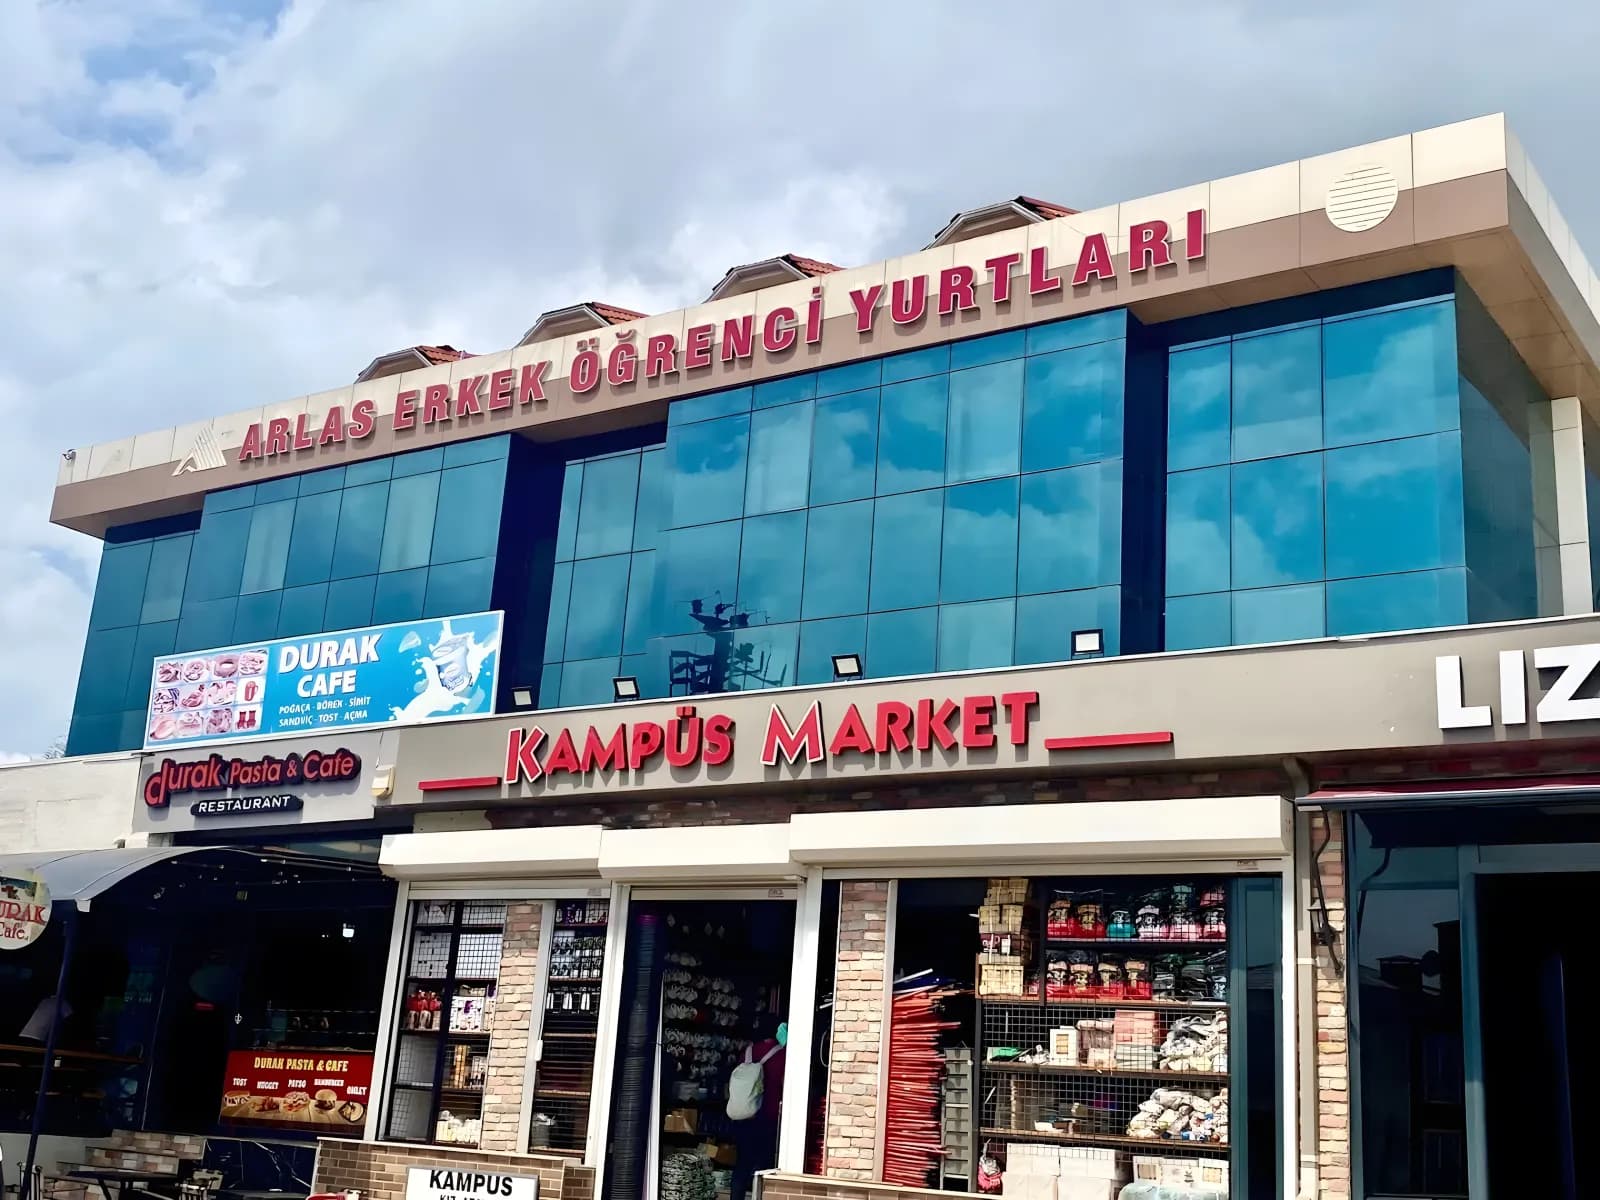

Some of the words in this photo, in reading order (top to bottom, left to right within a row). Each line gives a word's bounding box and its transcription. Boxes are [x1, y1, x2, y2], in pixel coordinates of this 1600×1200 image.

[238, 399, 376, 461] ARLAS
[392, 360, 551, 432] ERKEK
[569, 286, 822, 394] ÖĞRENCİ
[849, 208, 1206, 333] YURTLARI
[278, 633, 383, 674] DURAK
[297, 669, 357, 699] CAFE
[278, 703, 311, 715] POĞAÇA
[318, 712, 339, 723] TOST
[343, 709, 368, 722] AÇMA
[503, 705, 734, 785] KAMPÜS
[760, 691, 1039, 766] MARKET
[229, 759, 281, 786] Pasta
[286, 757, 298, 777] &
[303, 750, 355, 780] Cafe
[198, 795, 291, 813] RESTAURANT
[254, 1056, 285, 1070] DURAK
[286, 1058, 314, 1071] PASTA
[325, 1060, 349, 1072] CAFE
[429, 1169, 513, 1196] KAMPUS
